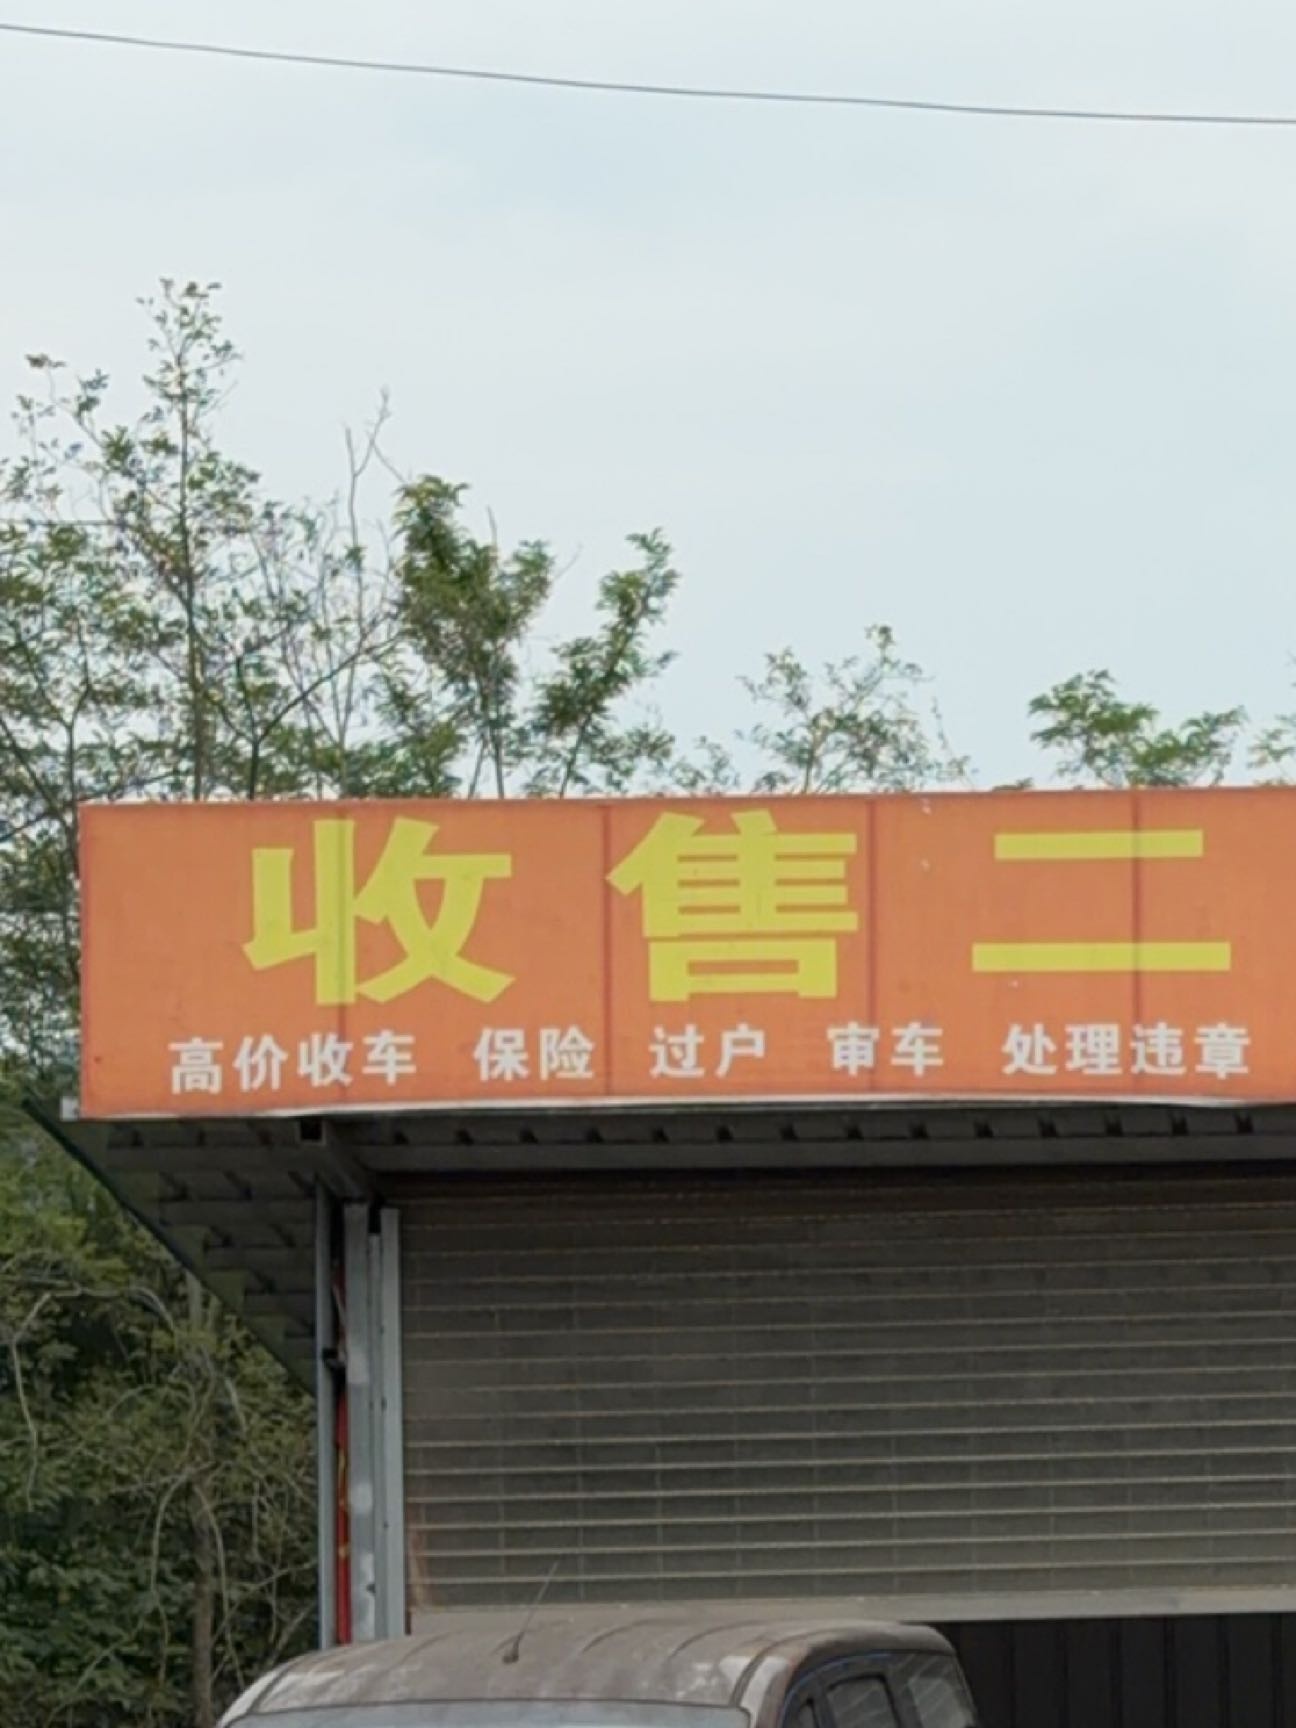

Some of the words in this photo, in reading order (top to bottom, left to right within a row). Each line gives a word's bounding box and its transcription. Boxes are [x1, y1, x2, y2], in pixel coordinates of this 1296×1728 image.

[169, 1029, 416, 1094] 高价收车
[473, 1026, 594, 1081] 保险
[650, 1023, 766, 1078] 过户
[827, 1021, 943, 1076] 审车
[1002, 1021, 1250, 1079] 处理违章
